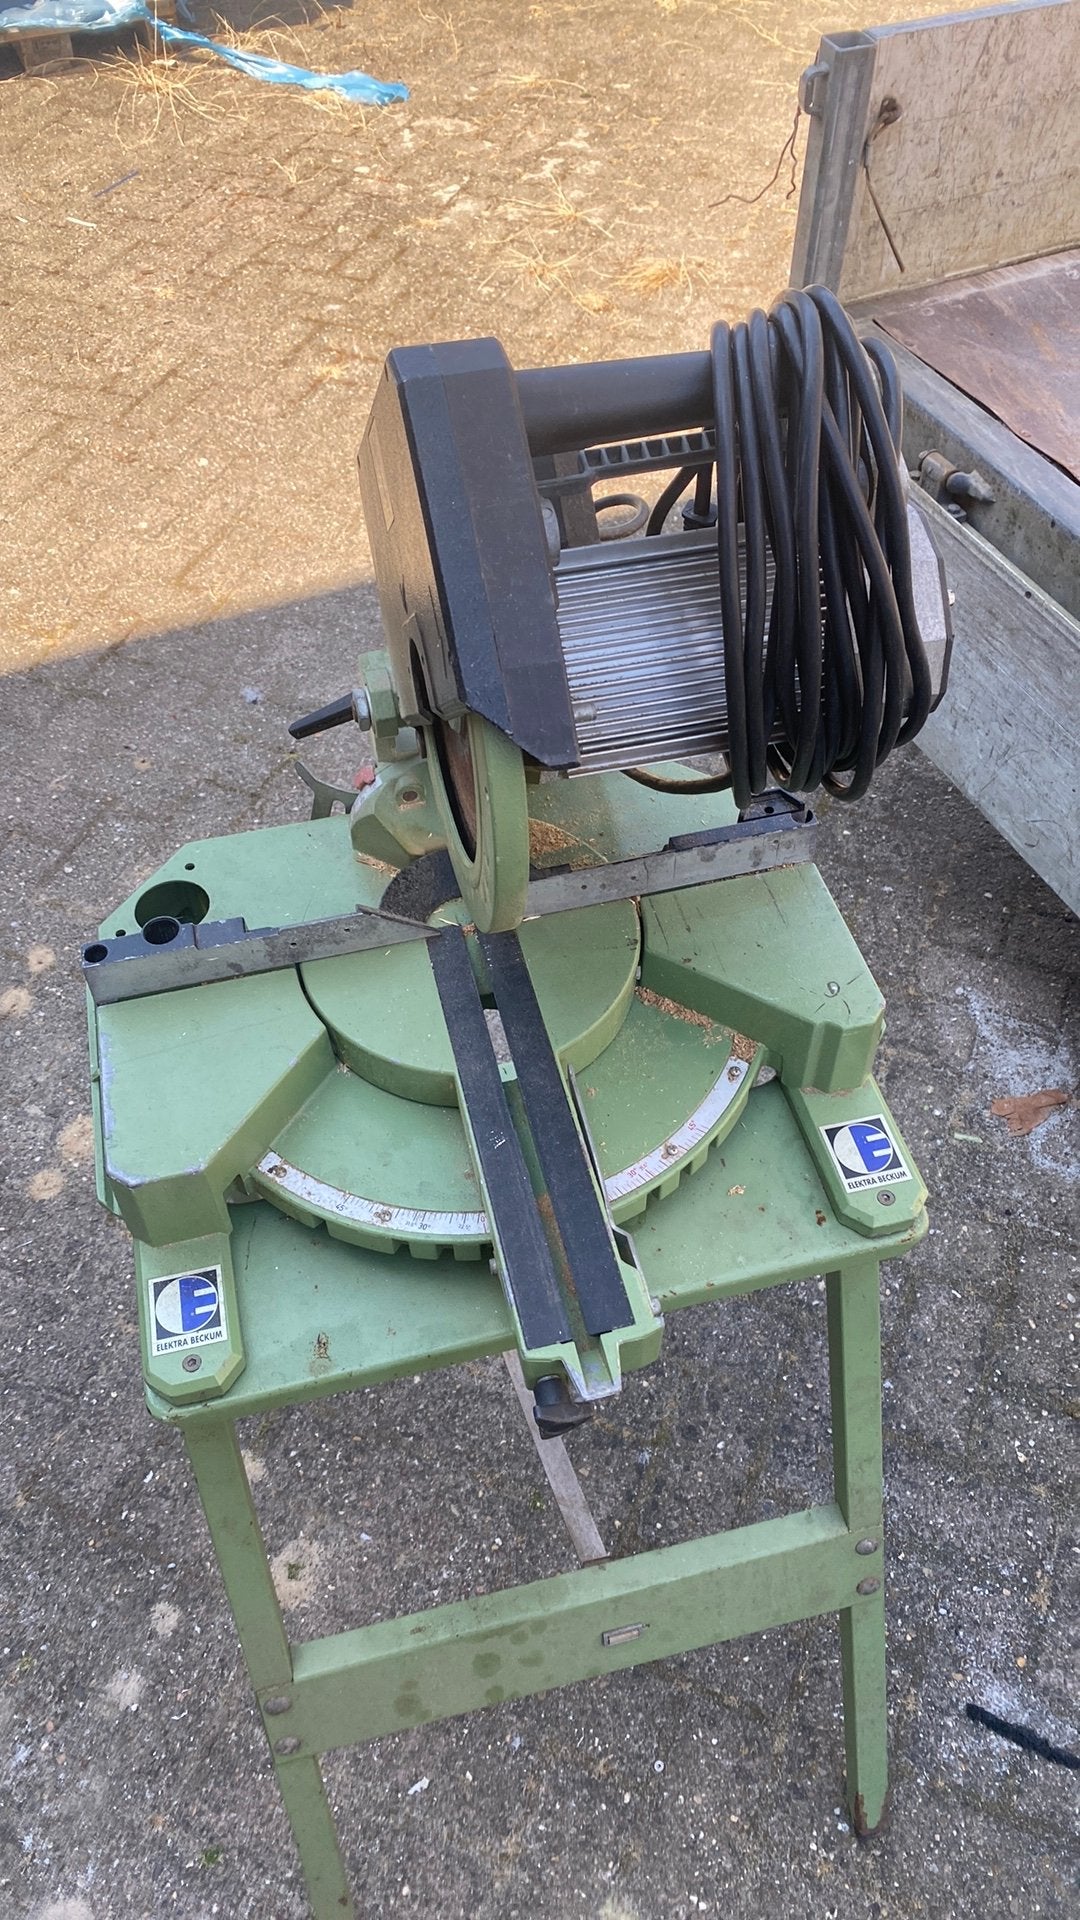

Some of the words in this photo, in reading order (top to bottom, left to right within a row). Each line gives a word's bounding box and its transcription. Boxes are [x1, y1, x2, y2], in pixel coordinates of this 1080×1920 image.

[847, 1177, 877, 1189] ELEKTRA
[878, 1170, 907, 1183] BECKUM
[156, 1338, 189, 1352] ELEKTRA
[190, 1331, 223, 1344] BECKUM
